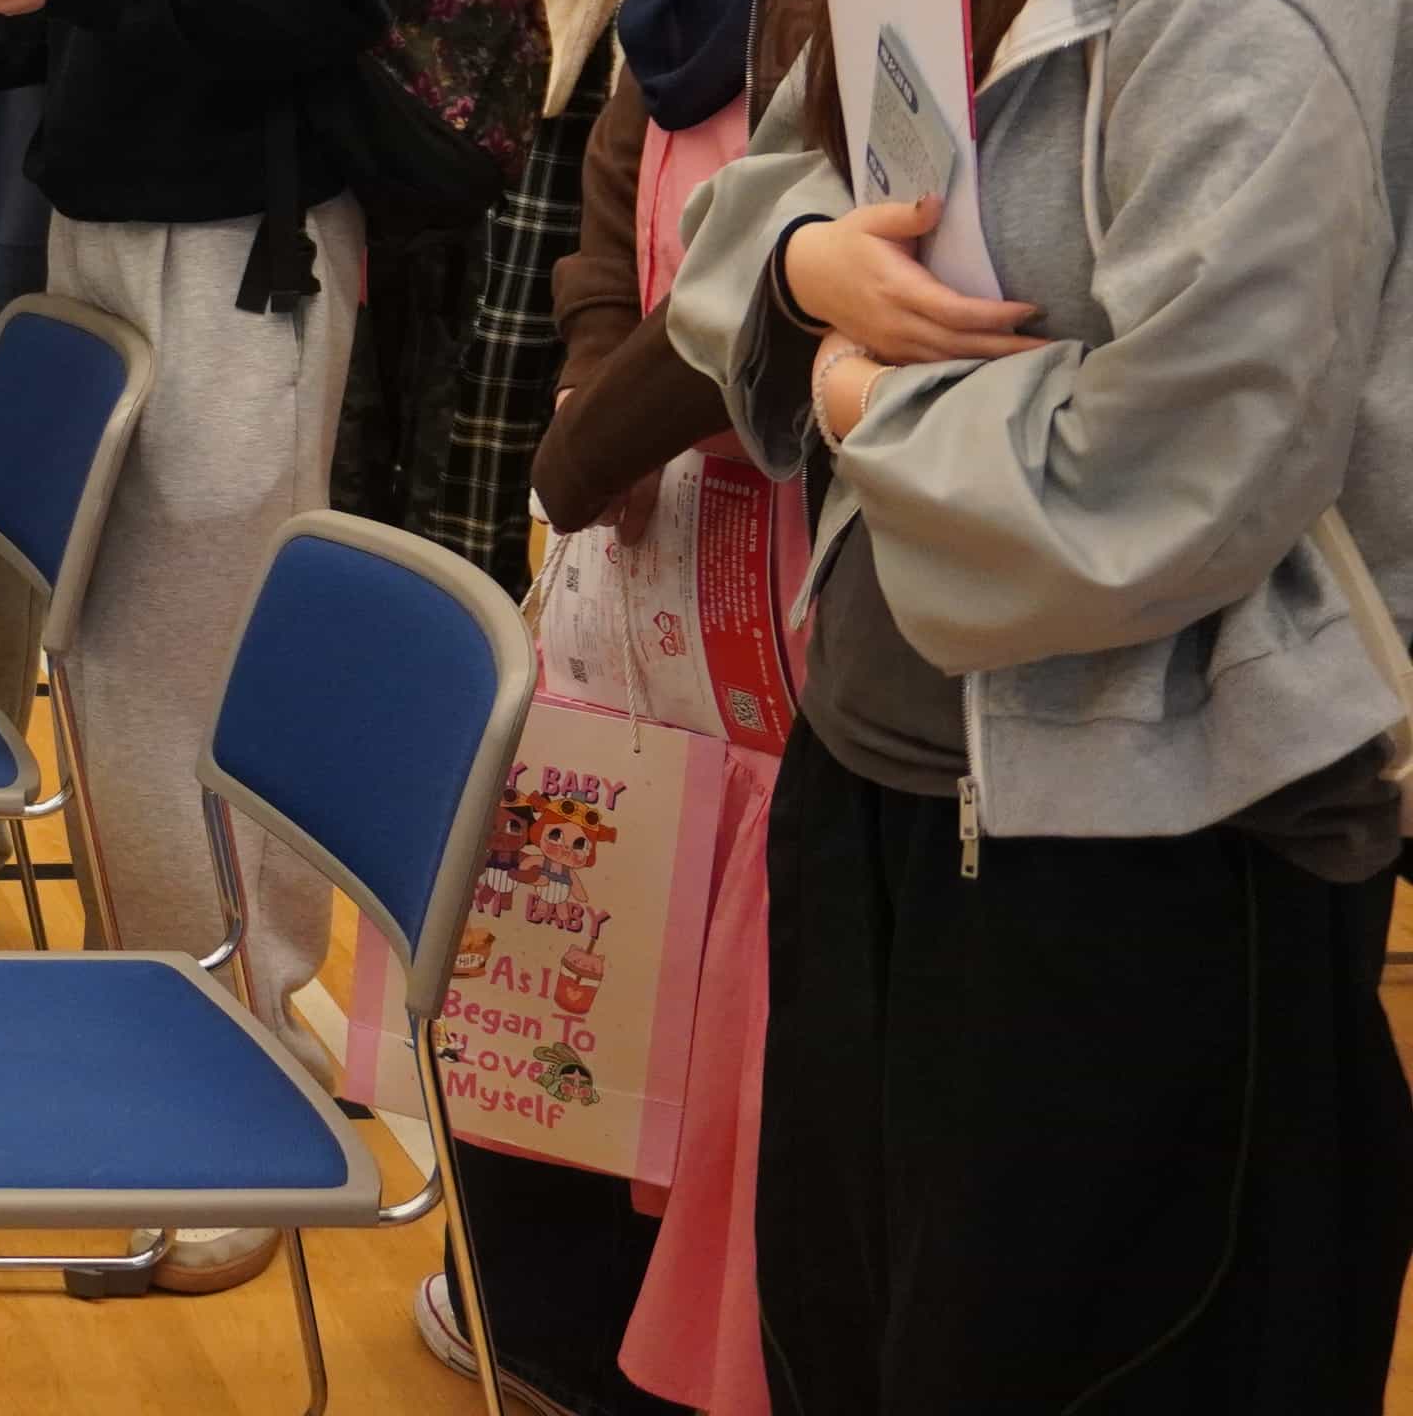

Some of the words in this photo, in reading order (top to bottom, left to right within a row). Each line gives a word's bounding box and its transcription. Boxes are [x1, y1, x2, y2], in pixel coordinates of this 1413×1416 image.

[541, 766, 627, 811] BABY
[490, 955, 533, 995] As
[538, 967, 552, 999] I
[442, 989, 542, 1041] Began
[551, 1012, 597, 1053] To
[458, 1032, 545, 1082] Love
[446, 1069, 566, 1129] Myself
